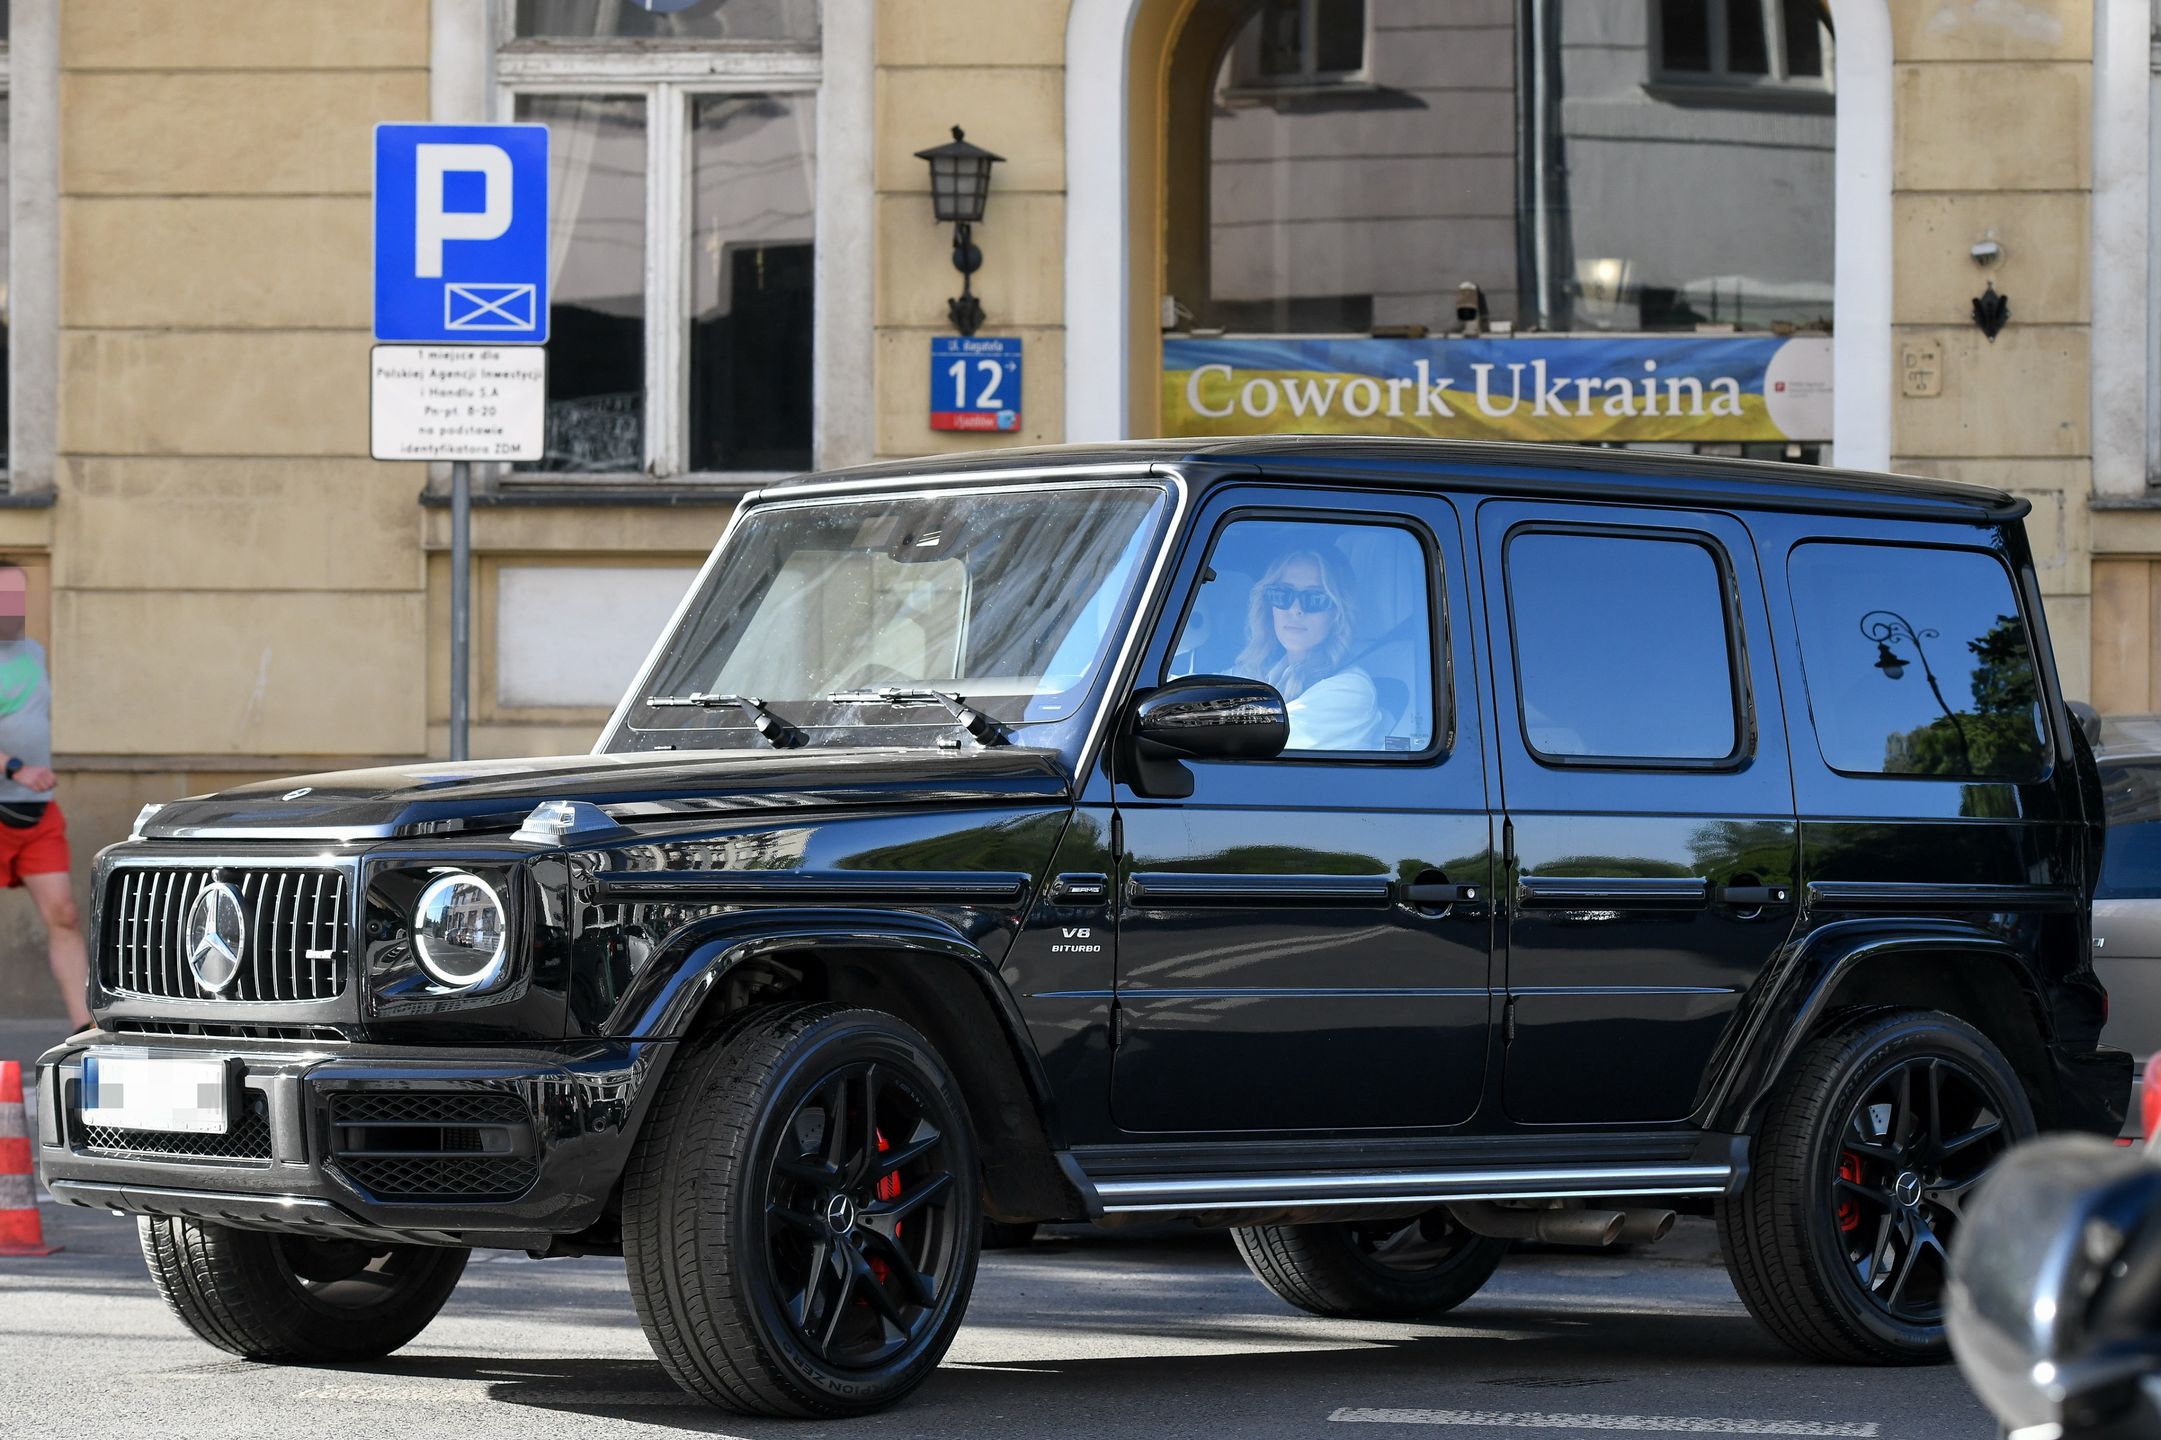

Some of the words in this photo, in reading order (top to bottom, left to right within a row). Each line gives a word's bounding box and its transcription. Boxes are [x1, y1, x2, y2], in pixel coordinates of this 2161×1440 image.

[415, 143, 514, 279] P
[428, 350, 475, 363] miejsce
[480, 350, 500, 361] dla
[376, 367, 425, 381] Polskiej
[429, 368, 477, 382] Agencji
[481, 369, 543, 382] Inwestycji
[948, 359, 1004, 409] 12
[1186, 358, 1456, 418] Cowork
[1469, 358, 1745, 418] Ukraina
[429, 387, 475, 398] Handlu
[467, 405, 497, 417] 8-20
[418, 427, 434, 435] na
[439, 425, 504, 436] podstawie
[400, 443, 490, 456] identyfikatora
[495, 443, 521, 454] ZDM
[1062, 927, 1091, 938] V8
[1051, 944, 1101, 953] BITURBO
